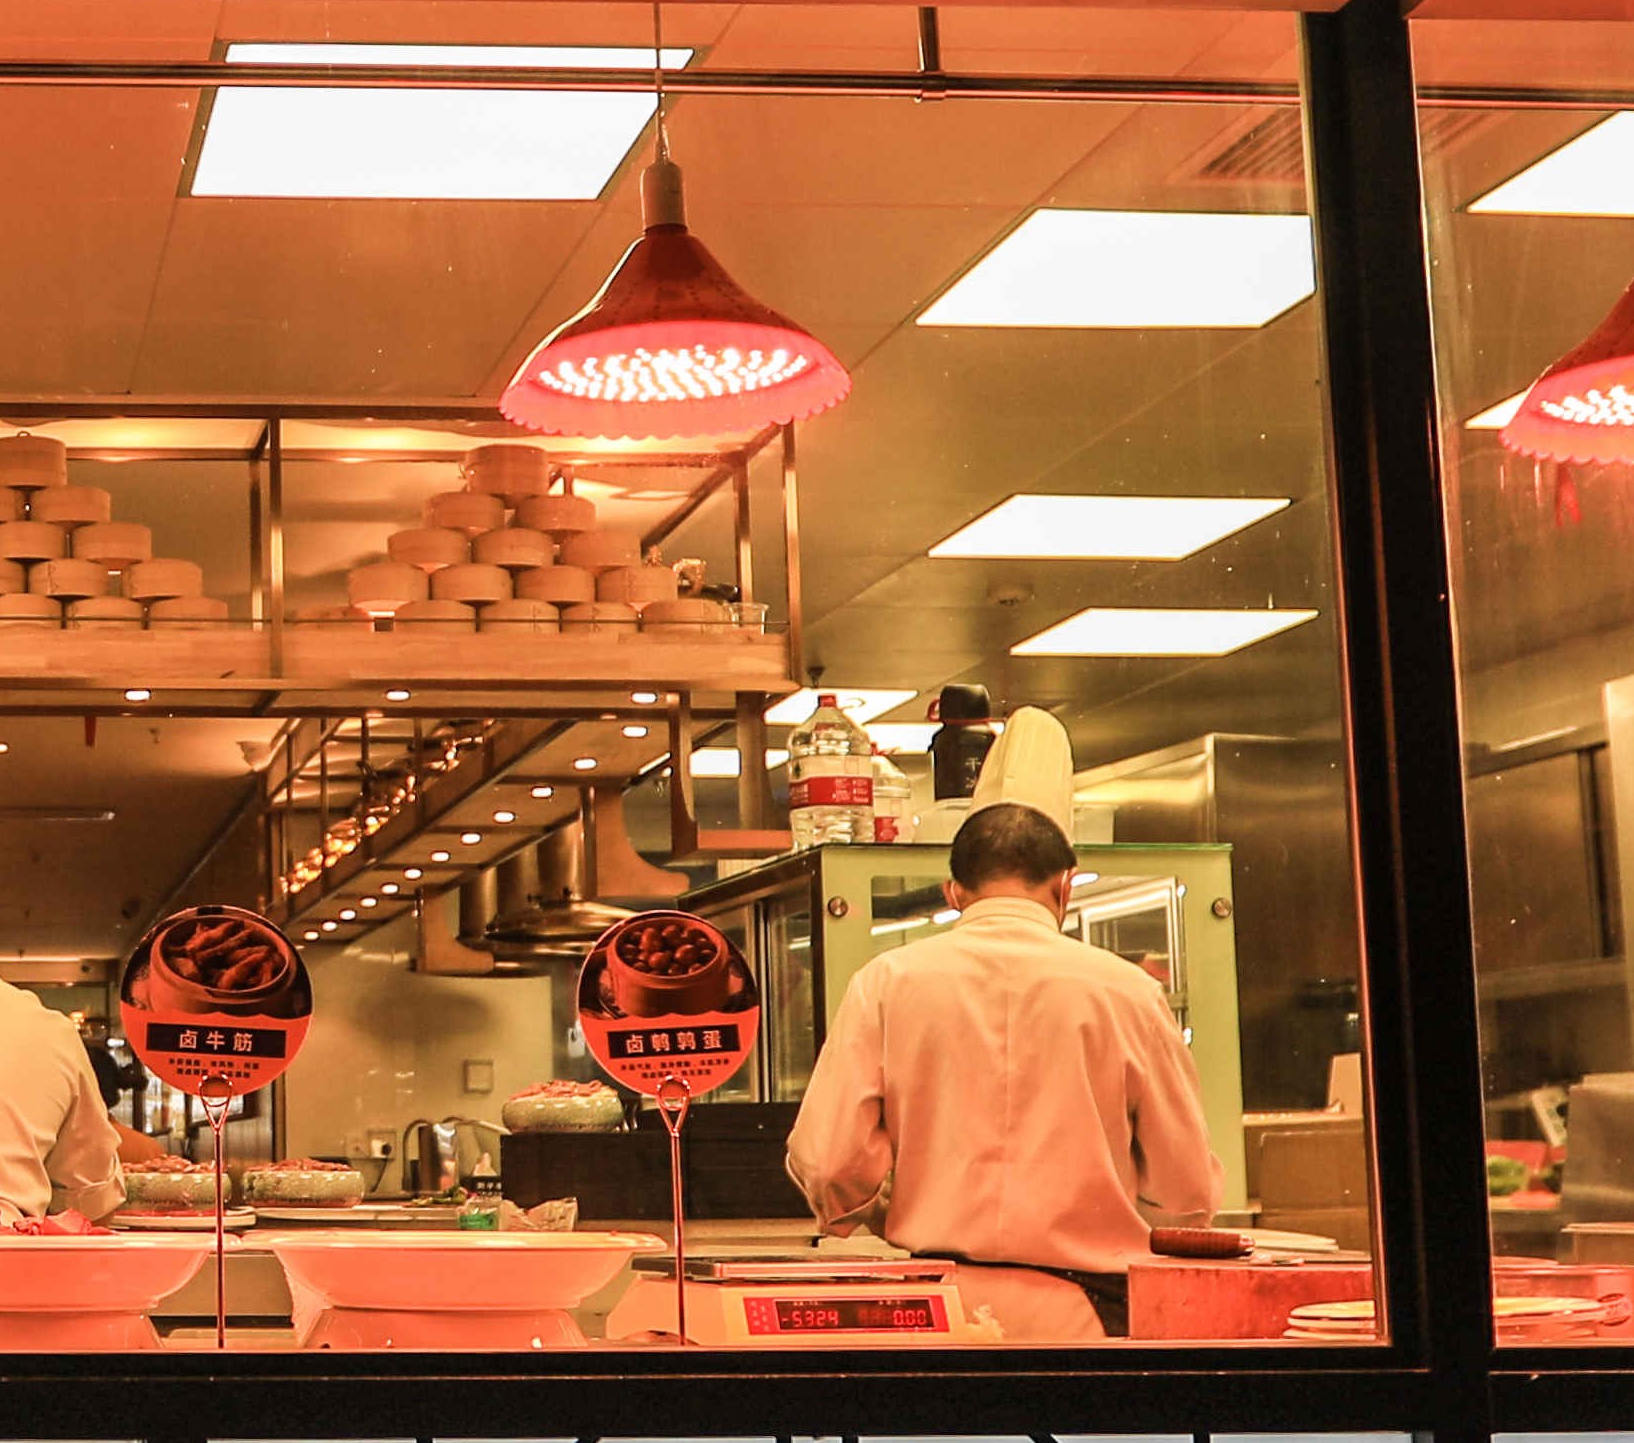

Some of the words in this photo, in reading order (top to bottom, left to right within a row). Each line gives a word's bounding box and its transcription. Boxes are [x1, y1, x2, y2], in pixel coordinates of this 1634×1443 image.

[179, 1029, 253, 1052] 卤牛筋
[625, 1029, 723, 1054] 卤鹌鹑蛋
